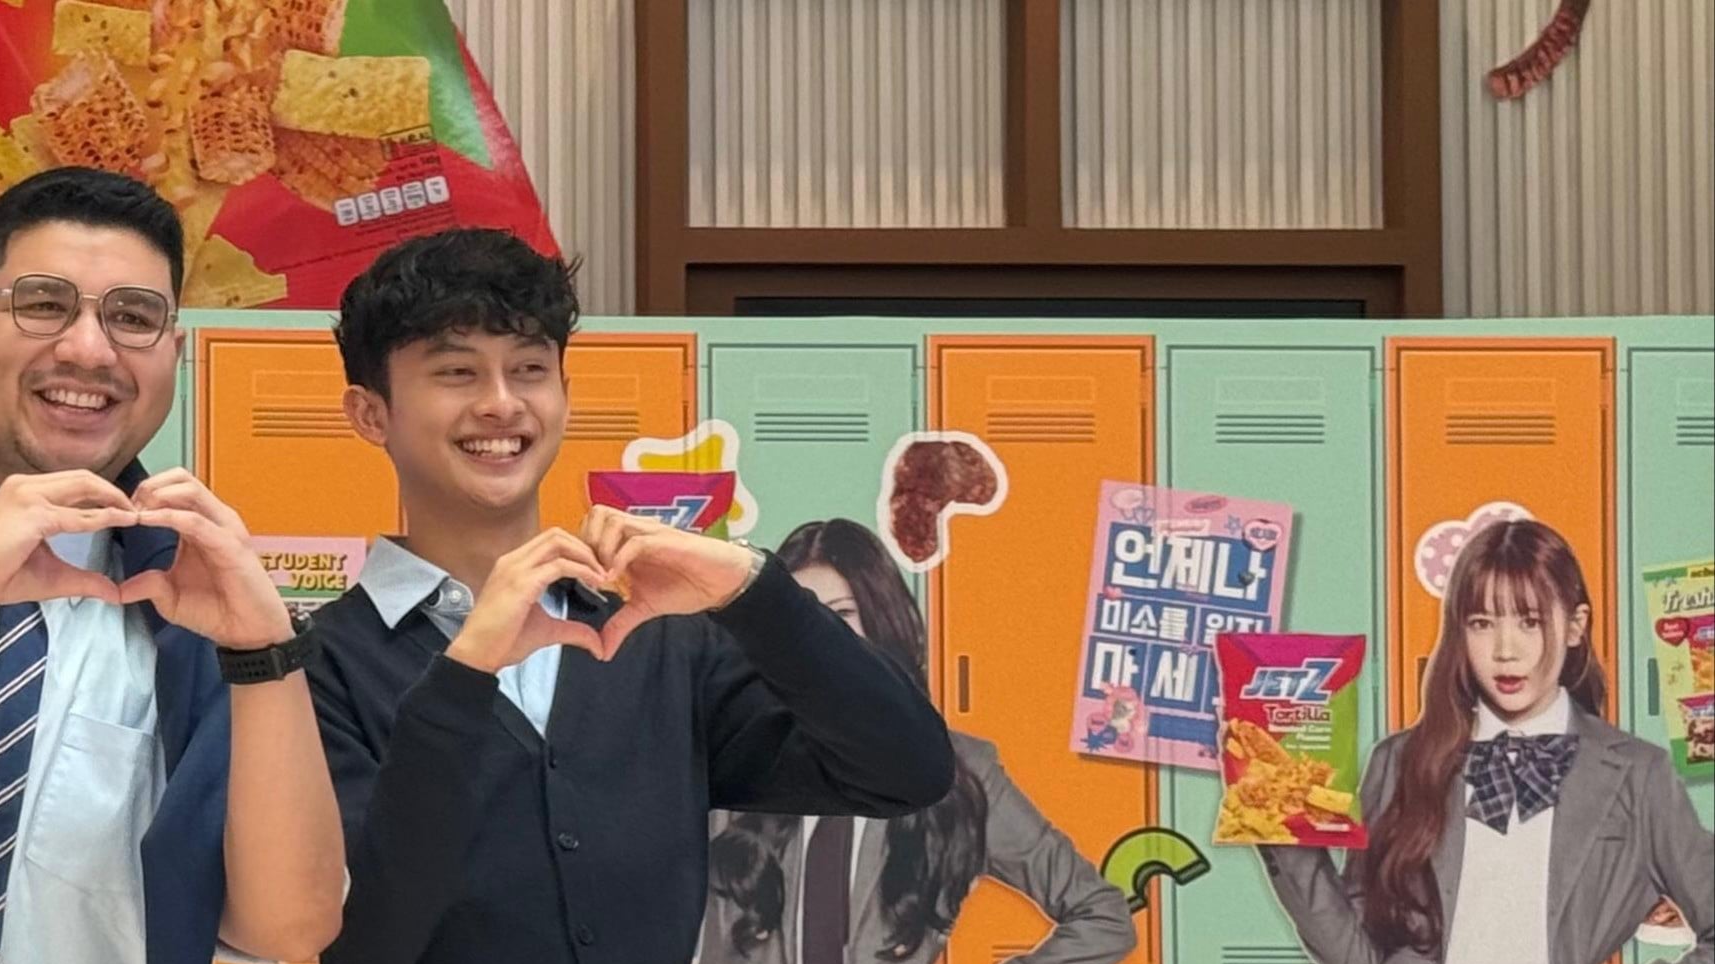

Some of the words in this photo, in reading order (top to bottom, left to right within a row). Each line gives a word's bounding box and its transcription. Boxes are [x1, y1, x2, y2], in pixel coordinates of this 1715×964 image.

[292, 573, 349, 592] VOICE
[1110, 529, 1268, 602] 언제나
[1099, 598, 1189, 642] 미소를
[1091, 641, 1222, 706] 마세
[1240, 657, 1343, 704] JETZ
[1263, 704, 1333, 723] Tortilla
